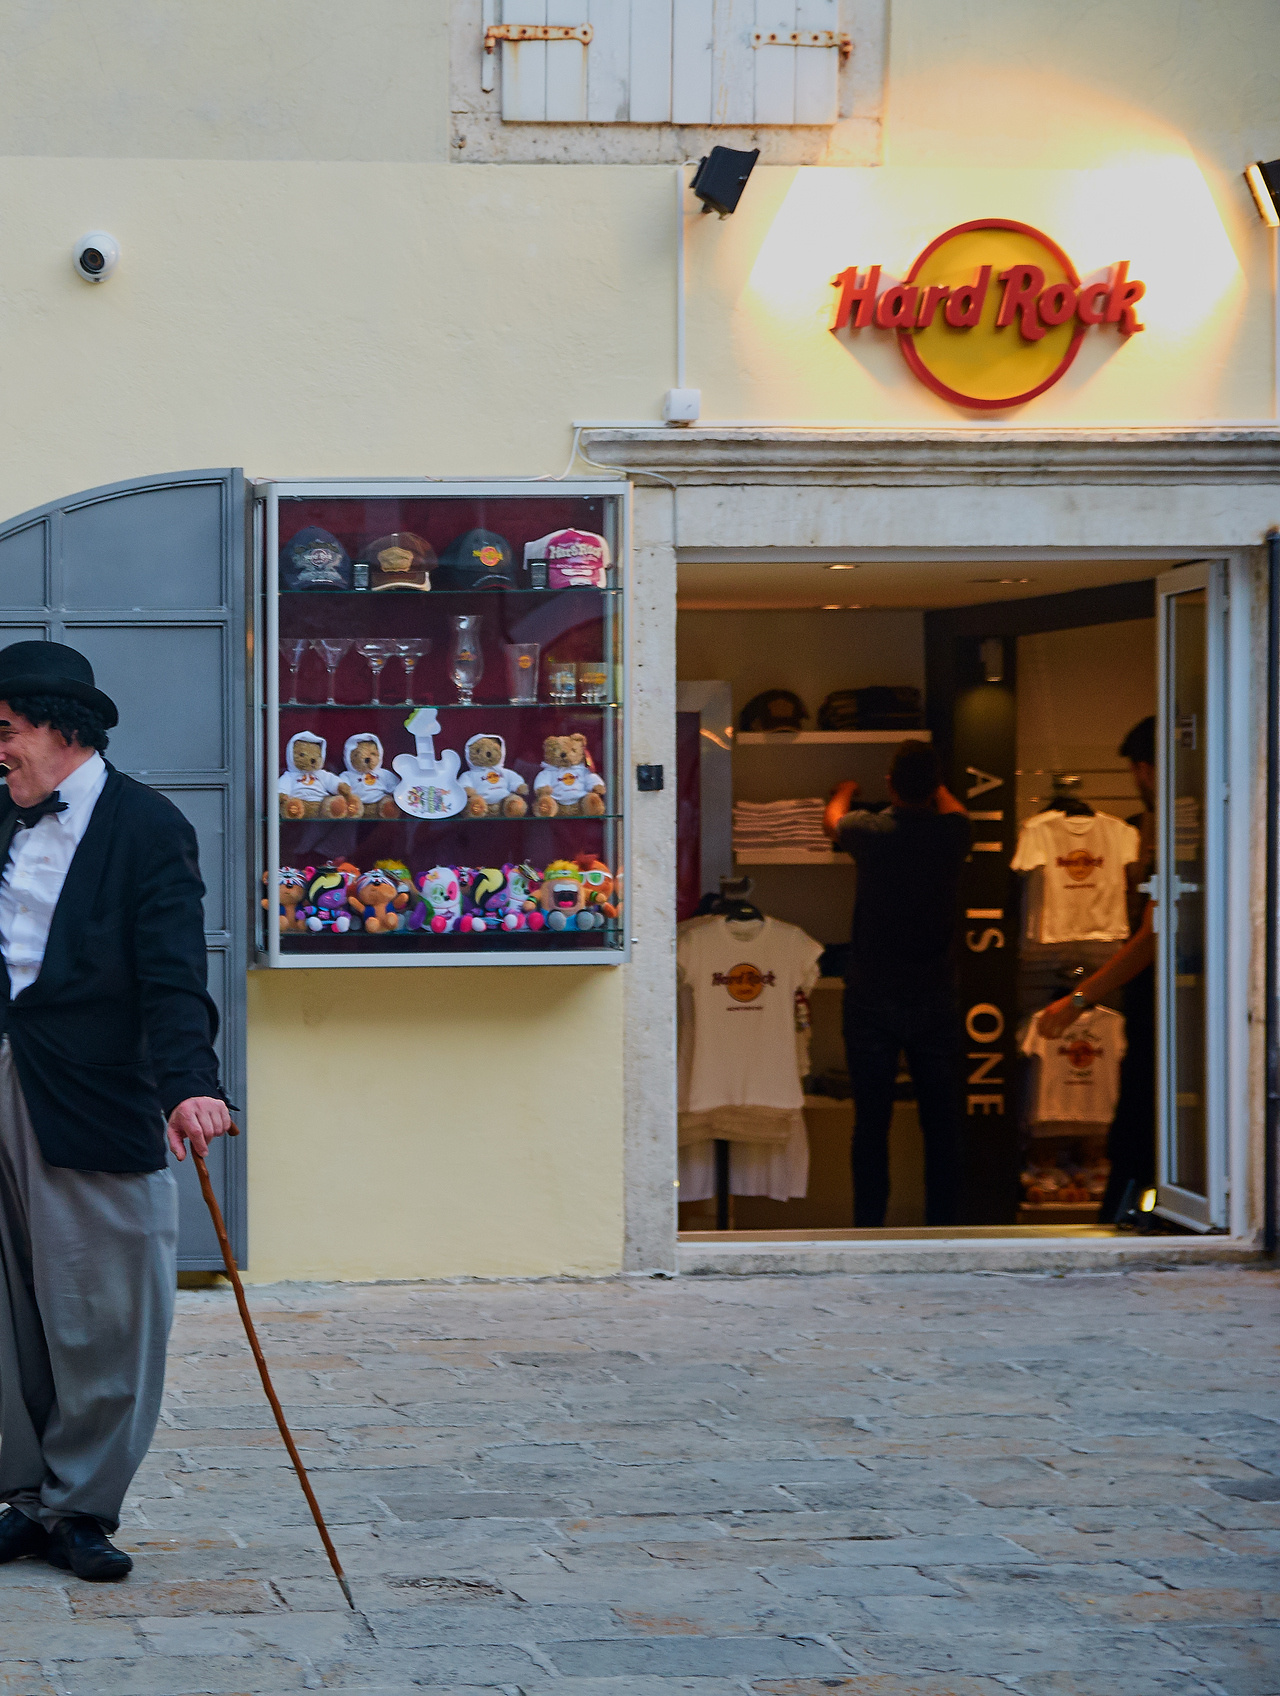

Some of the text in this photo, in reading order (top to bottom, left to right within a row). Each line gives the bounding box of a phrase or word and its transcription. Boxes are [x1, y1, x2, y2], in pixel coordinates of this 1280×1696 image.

[829, 261, 1146, 341] Hard Rock
[965, 908, 1006, 953] IS
[965, 1002, 1006, 1116] ONE
